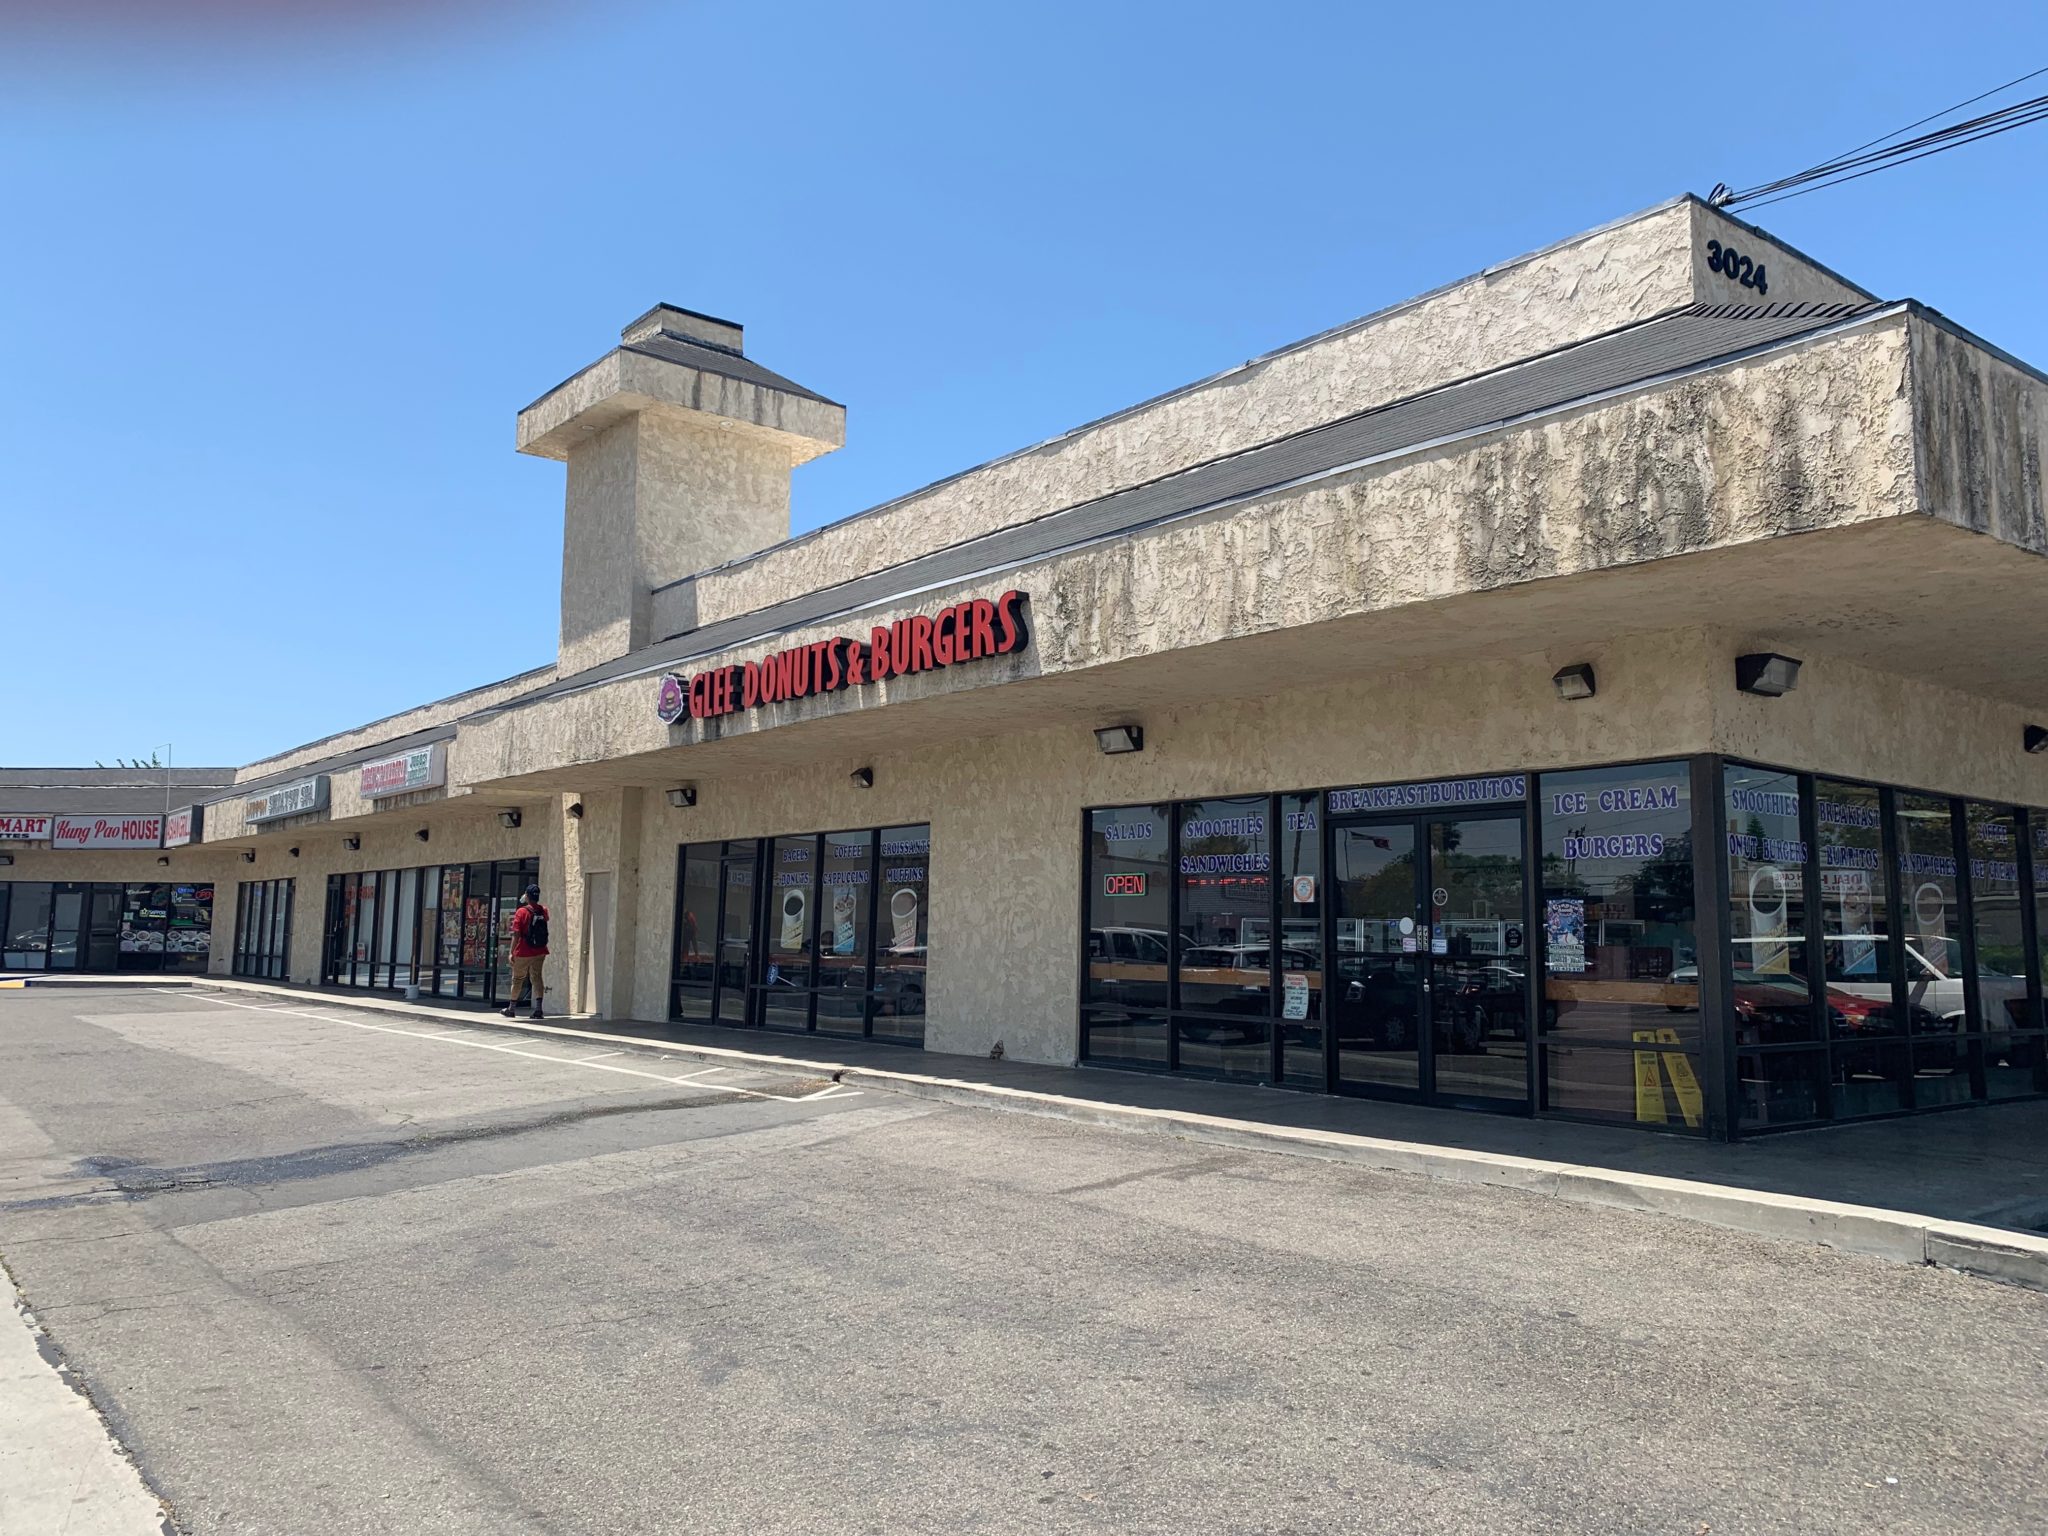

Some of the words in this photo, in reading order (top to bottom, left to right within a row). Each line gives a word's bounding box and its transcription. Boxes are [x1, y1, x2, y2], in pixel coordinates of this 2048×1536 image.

[1707, 239, 1768, 295] 3024
[689, 664, 735, 719] GLEE
[744, 636, 843, 708] DONUTS
[846, 640, 868, 685] &
[871, 590, 1019, 681] BURGERS
[1328, 785, 1427, 811] BREAKFAST
[1428, 777, 1526, 803] BURRITOS
[1553, 792, 1587, 815] ICE
[1599, 785, 1679, 812] CREAM
[1732, 789, 1798, 817] SMOOTHIES
[0, 818, 47, 832] MART
[1287, 812, 1317, 831] TEA
[1819, 802, 1881, 828] BREAKFAST
[56, 820, 91, 844] Kung
[94, 819, 120, 840] Pao
[121, 820, 160, 840] HOUSE
[1105, 823, 1152, 841] SALADS
[1186, 816, 1263, 839] SMOOTHIES
[783, 849, 808, 862] BAGELS
[834, 844, 862, 859] COFFEE
[1563, 833, 1664, 859] BURGERS
[1727, 833, 1758, 859] ONUT
[1762, 838, 1808, 863] BURGERS
[1826, 845, 1879, 870] BURRITOS
[886, 867, 924, 882] MUFFINS
[1181, 853, 1270, 873] SANDWICHES
[1900, 853, 1957, 877] ANDWICHES
[1970, 859, 1984, 878] ICE
[780, 872, 809, 885] DONUTS
[823, 870, 869, 885] CAPPUCCINO
[1106, 875, 1144, 894] OPEN
